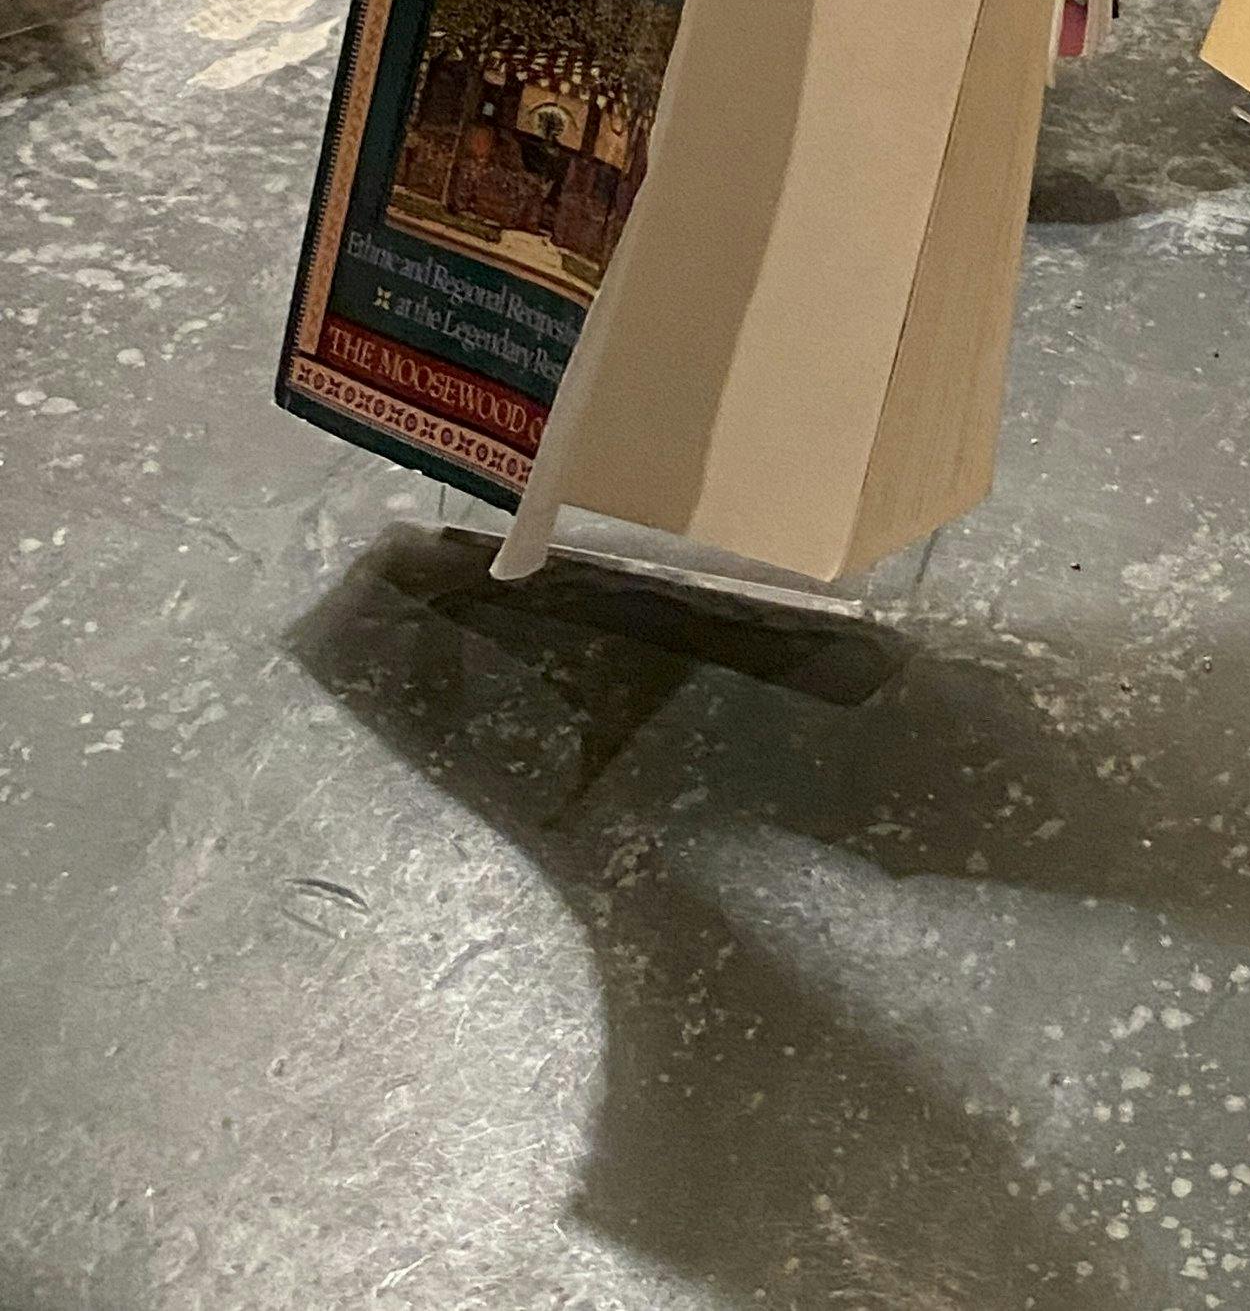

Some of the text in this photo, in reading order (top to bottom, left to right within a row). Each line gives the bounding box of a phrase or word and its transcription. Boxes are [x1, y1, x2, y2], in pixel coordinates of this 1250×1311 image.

[397, 255, 435, 286] and
[431, 263, 508, 314] Regional
[410, 294, 442, 330] the
[440, 310, 540, 374] Legendary
[328, 326, 377, 371] THE
[377, 350, 528, 434] MOOSEWOOD
